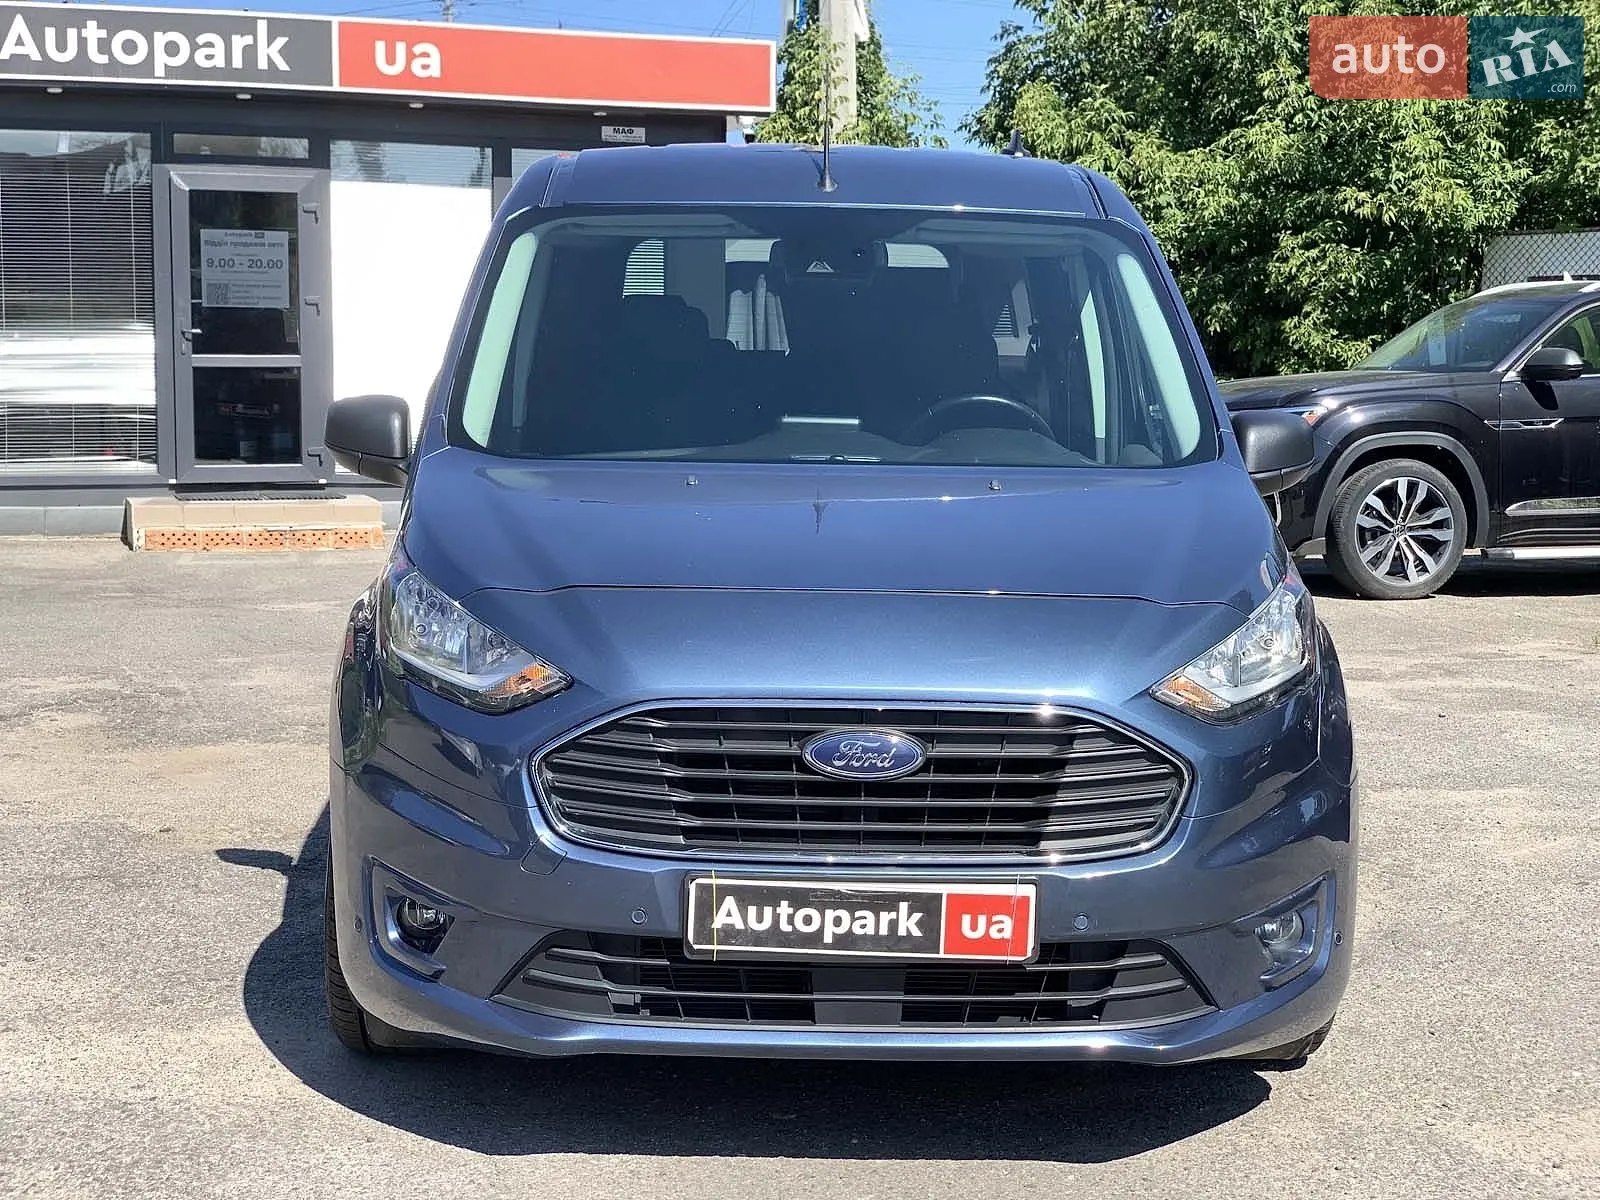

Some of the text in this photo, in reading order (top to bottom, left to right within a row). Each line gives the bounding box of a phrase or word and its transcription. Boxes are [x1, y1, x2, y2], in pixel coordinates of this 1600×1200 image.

[0, 13, 441, 78] Autopark ua
[612, 127, 634, 135] МАФ
[206, 258, 236, 269] 9.00
[247, 259, 284, 270] 20.00
[832, 740, 897, 767] Ford
[711, 895, 1012, 944] Autopark ua
